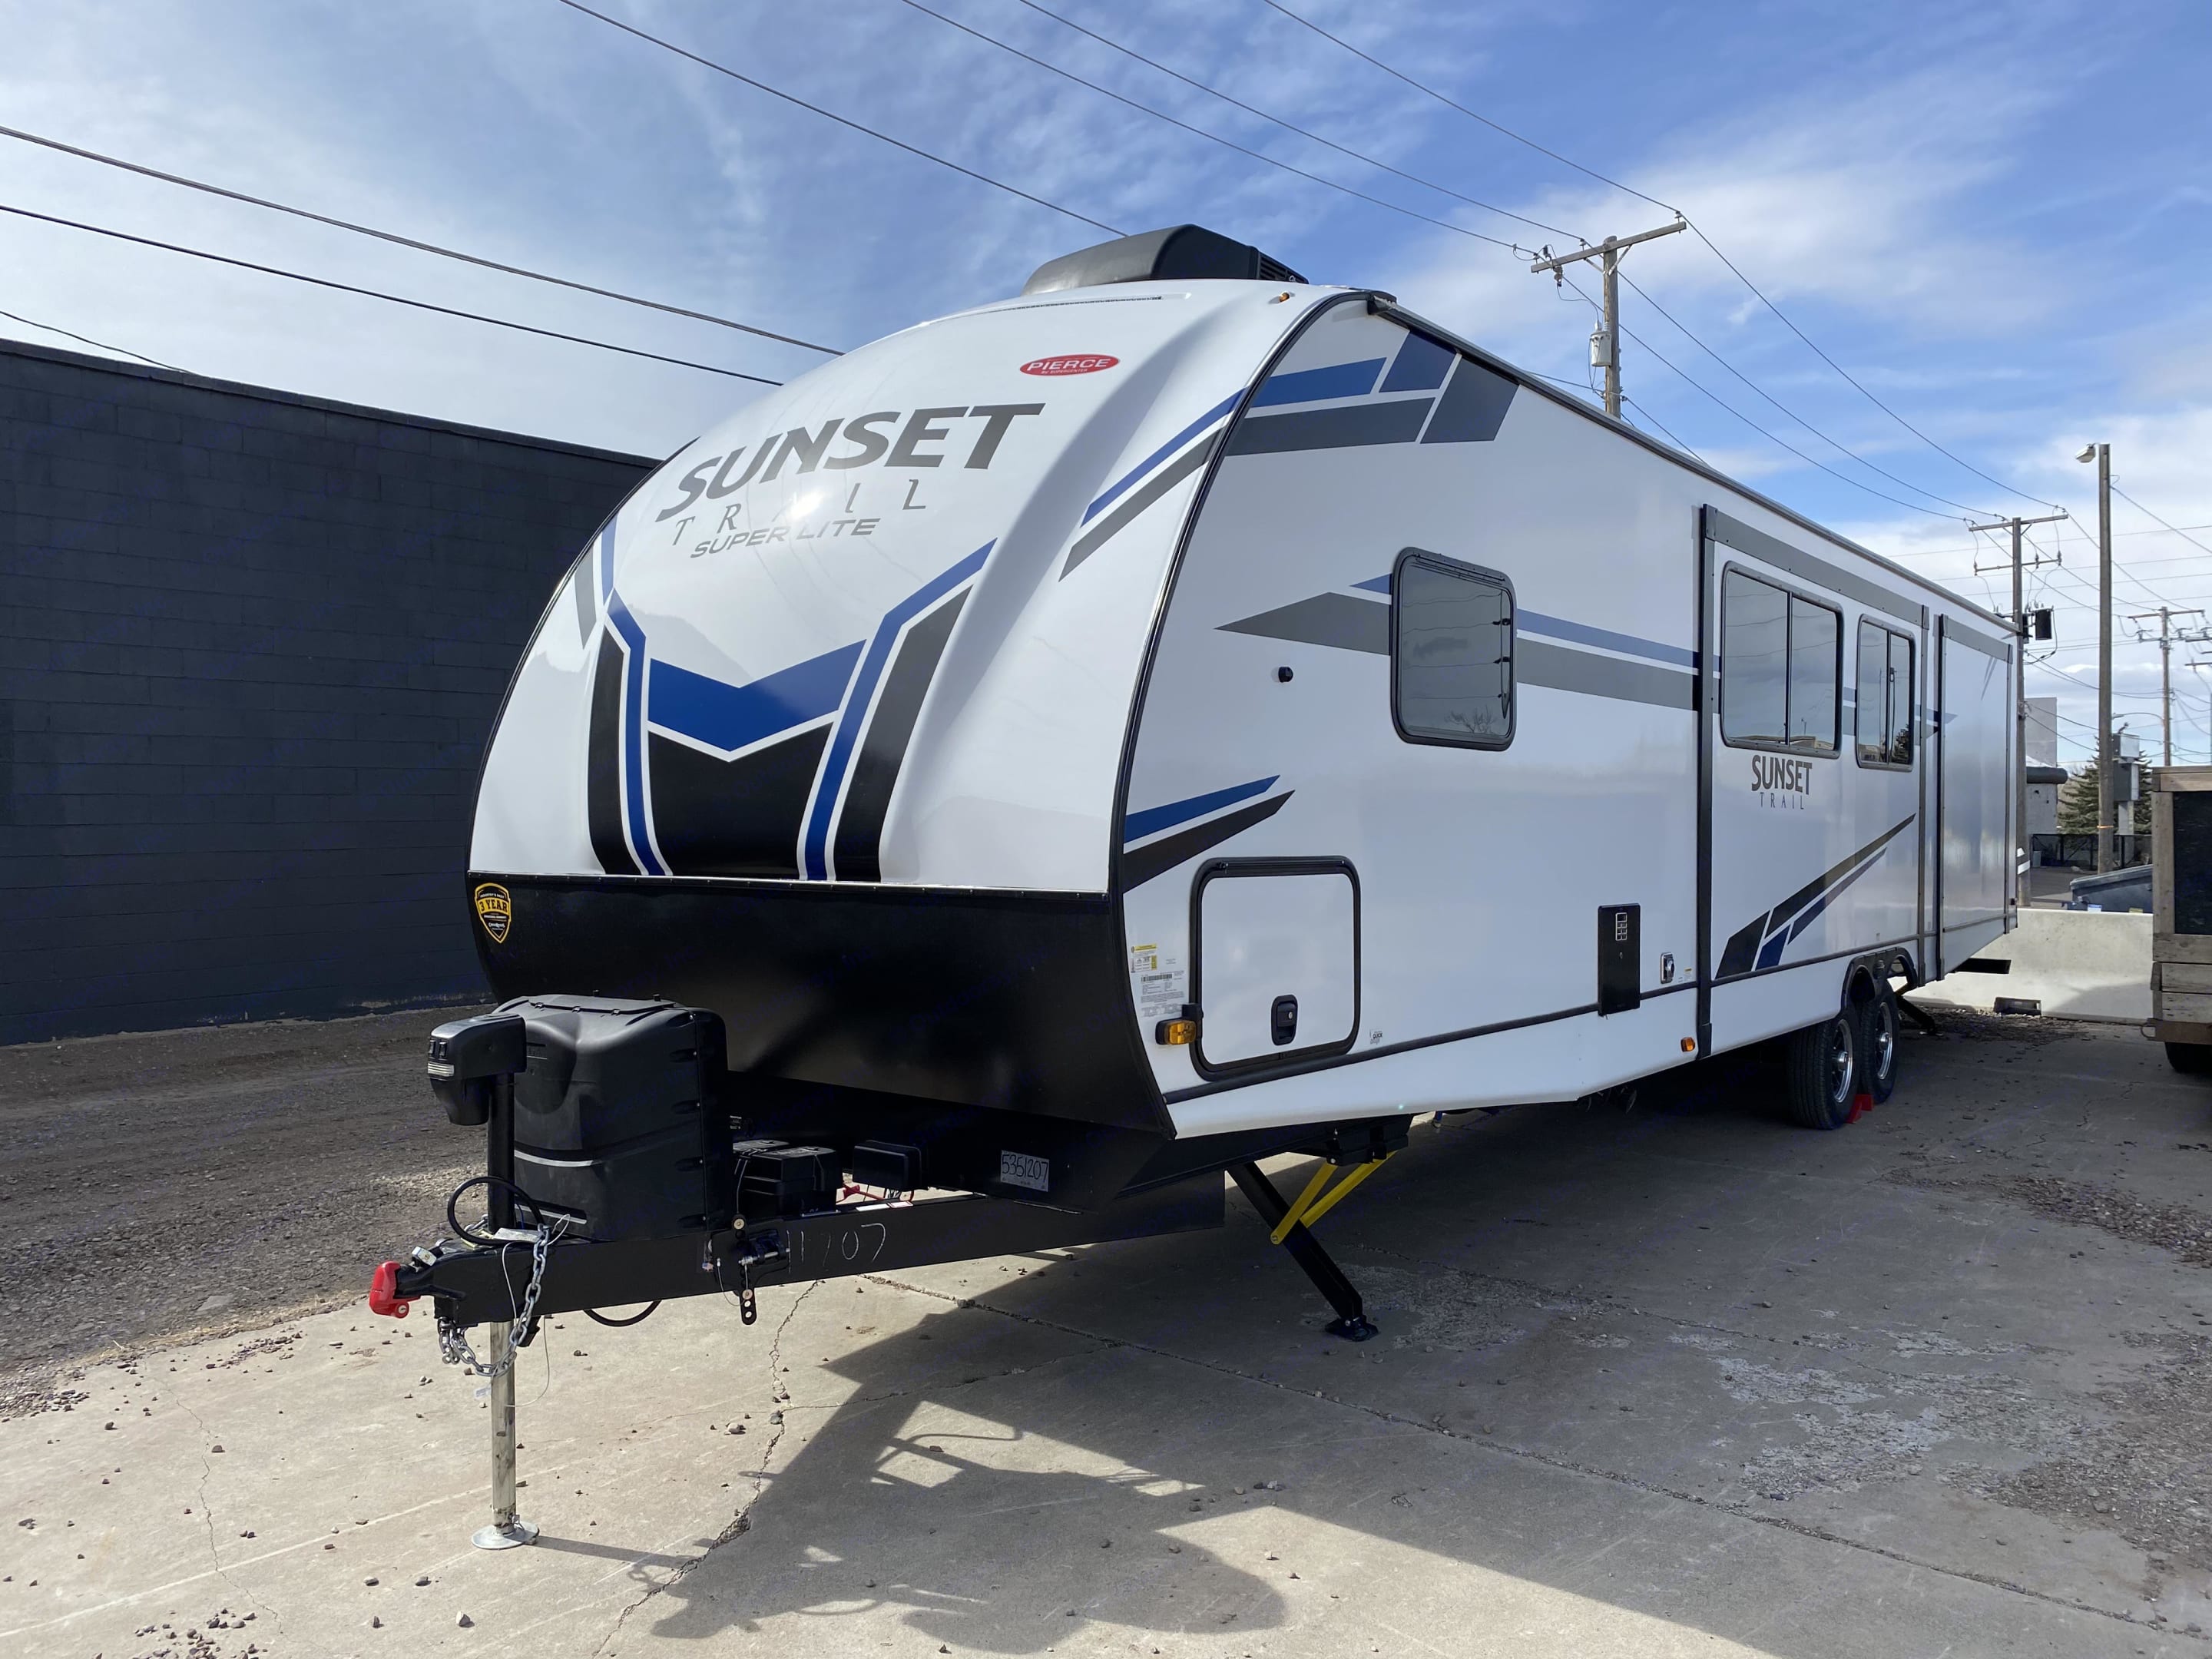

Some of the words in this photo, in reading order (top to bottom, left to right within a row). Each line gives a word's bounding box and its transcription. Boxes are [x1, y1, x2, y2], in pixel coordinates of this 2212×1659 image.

[1027, 359, 1111, 371] PIERCE
[655, 402, 1045, 522] SUNSET
[673, 478, 926, 545] TRIL
[690, 525, 791, 558] SUPER
[796, 517, 881, 539] LITE
[1752, 754, 1813, 795] SUNSET
[1760, 792, 1804, 810] TRAIL
[479, 901, 485, 912] 3
[485, 899, 508, 913] YEAR
[1002, 1154, 1048, 1183] 5351207
